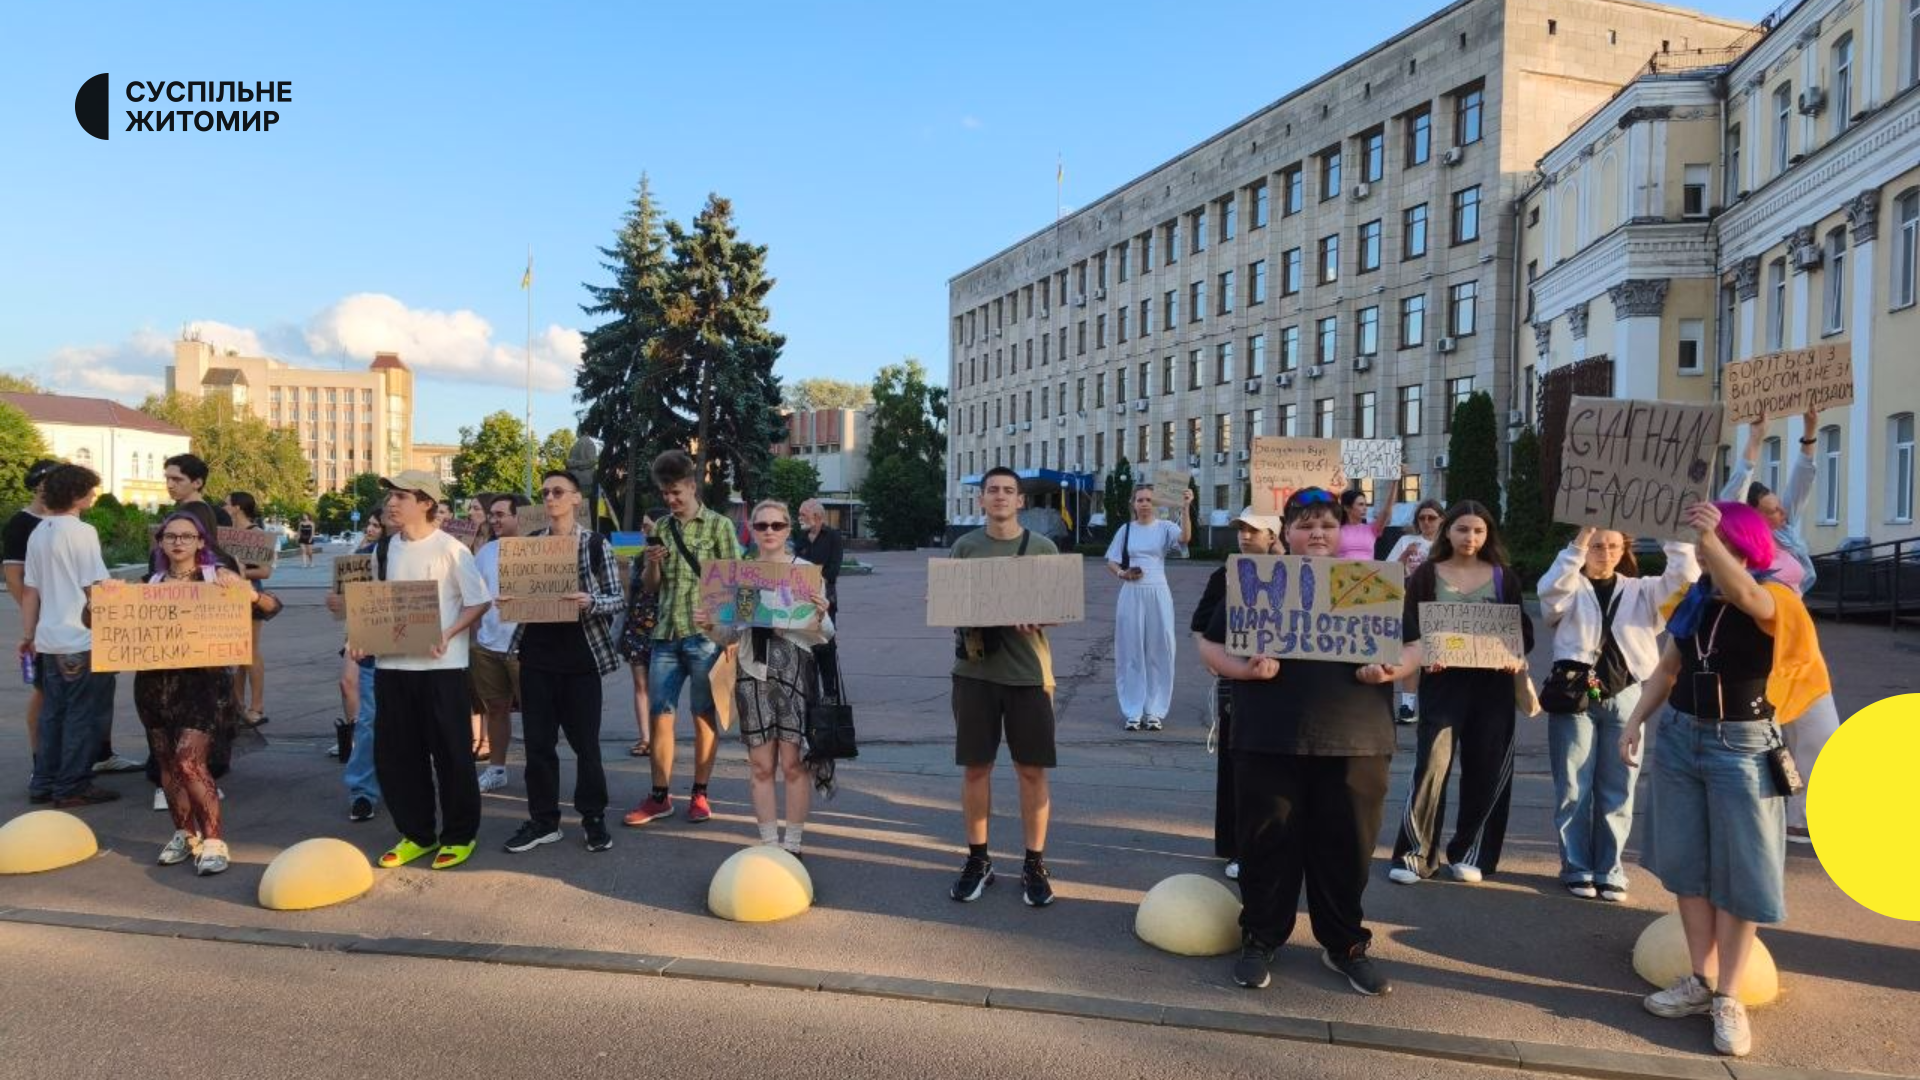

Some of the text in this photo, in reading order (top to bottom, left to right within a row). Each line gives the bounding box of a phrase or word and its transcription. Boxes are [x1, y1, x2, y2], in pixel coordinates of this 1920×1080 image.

[143, 586, 199, 600] ВИМОГИ
[1237, 557, 1315, 611] НІ
[93, 604, 178, 621] ФЕДОРОВ
[1230, 606, 1283, 631] НАМ
[101, 623, 183, 643] ДРАПАТИЙ
[108, 645, 190, 663] СИРСЬКИЙ
